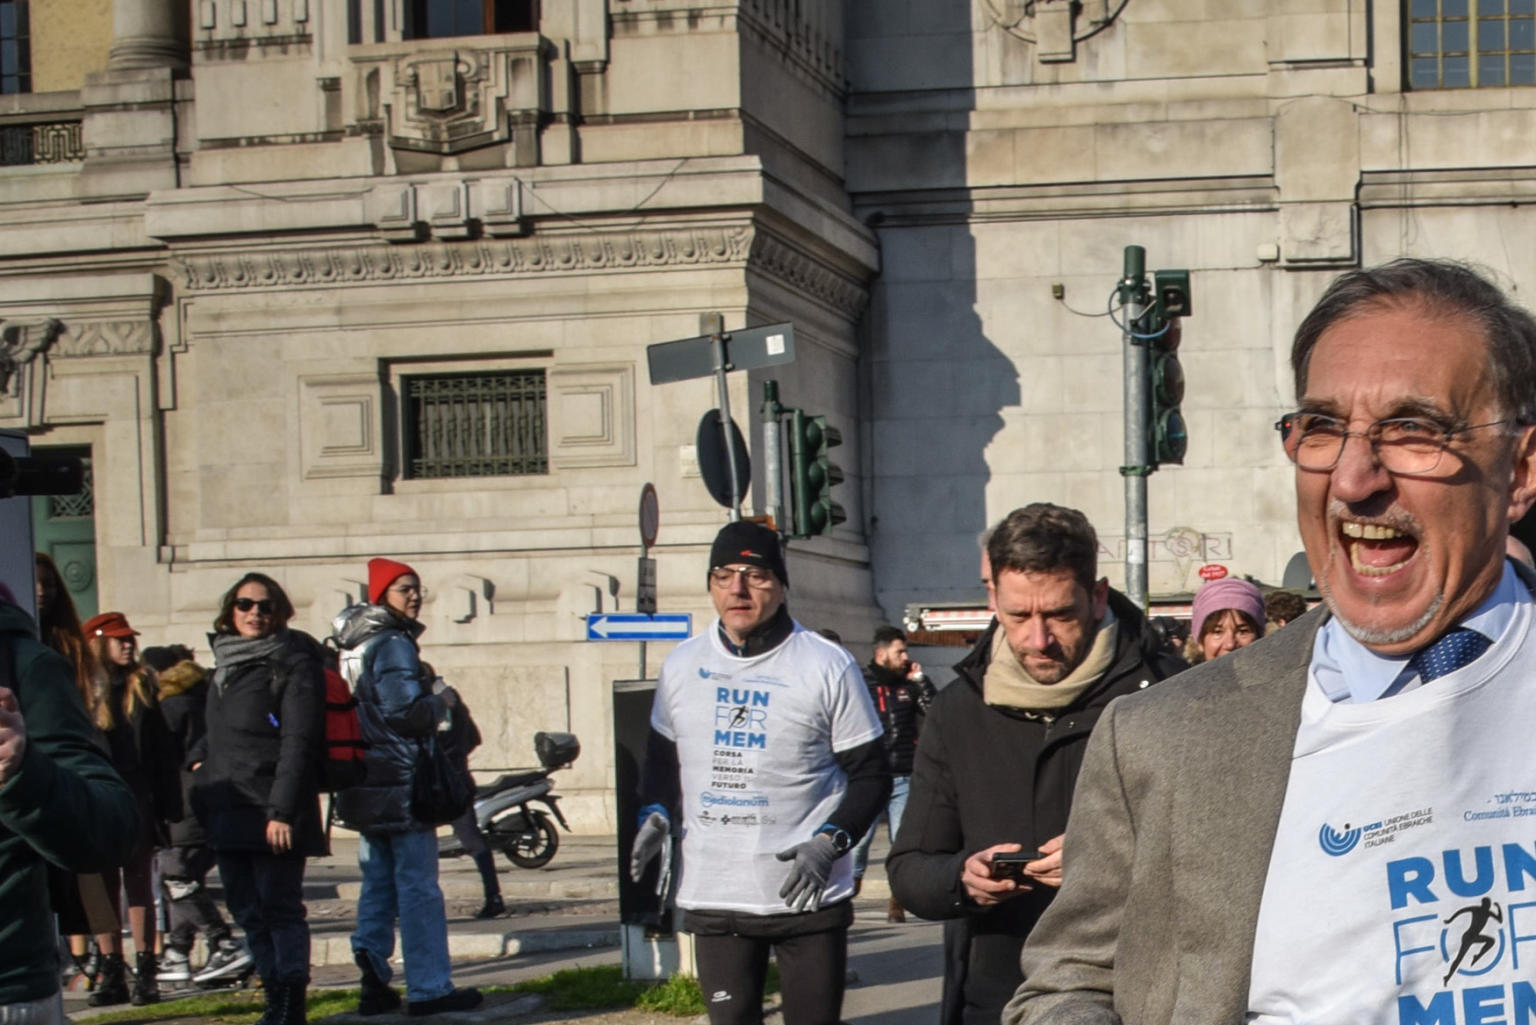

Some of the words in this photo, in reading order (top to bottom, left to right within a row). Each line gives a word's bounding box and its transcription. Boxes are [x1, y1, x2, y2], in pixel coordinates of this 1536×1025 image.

[717, 687, 770, 707] RUN
[715, 706, 767, 730] FOR
[714, 730, 766, 749] MEM
[713, 766, 753, 774] MEMORIA
[712, 781, 746, 789] FUTURO
